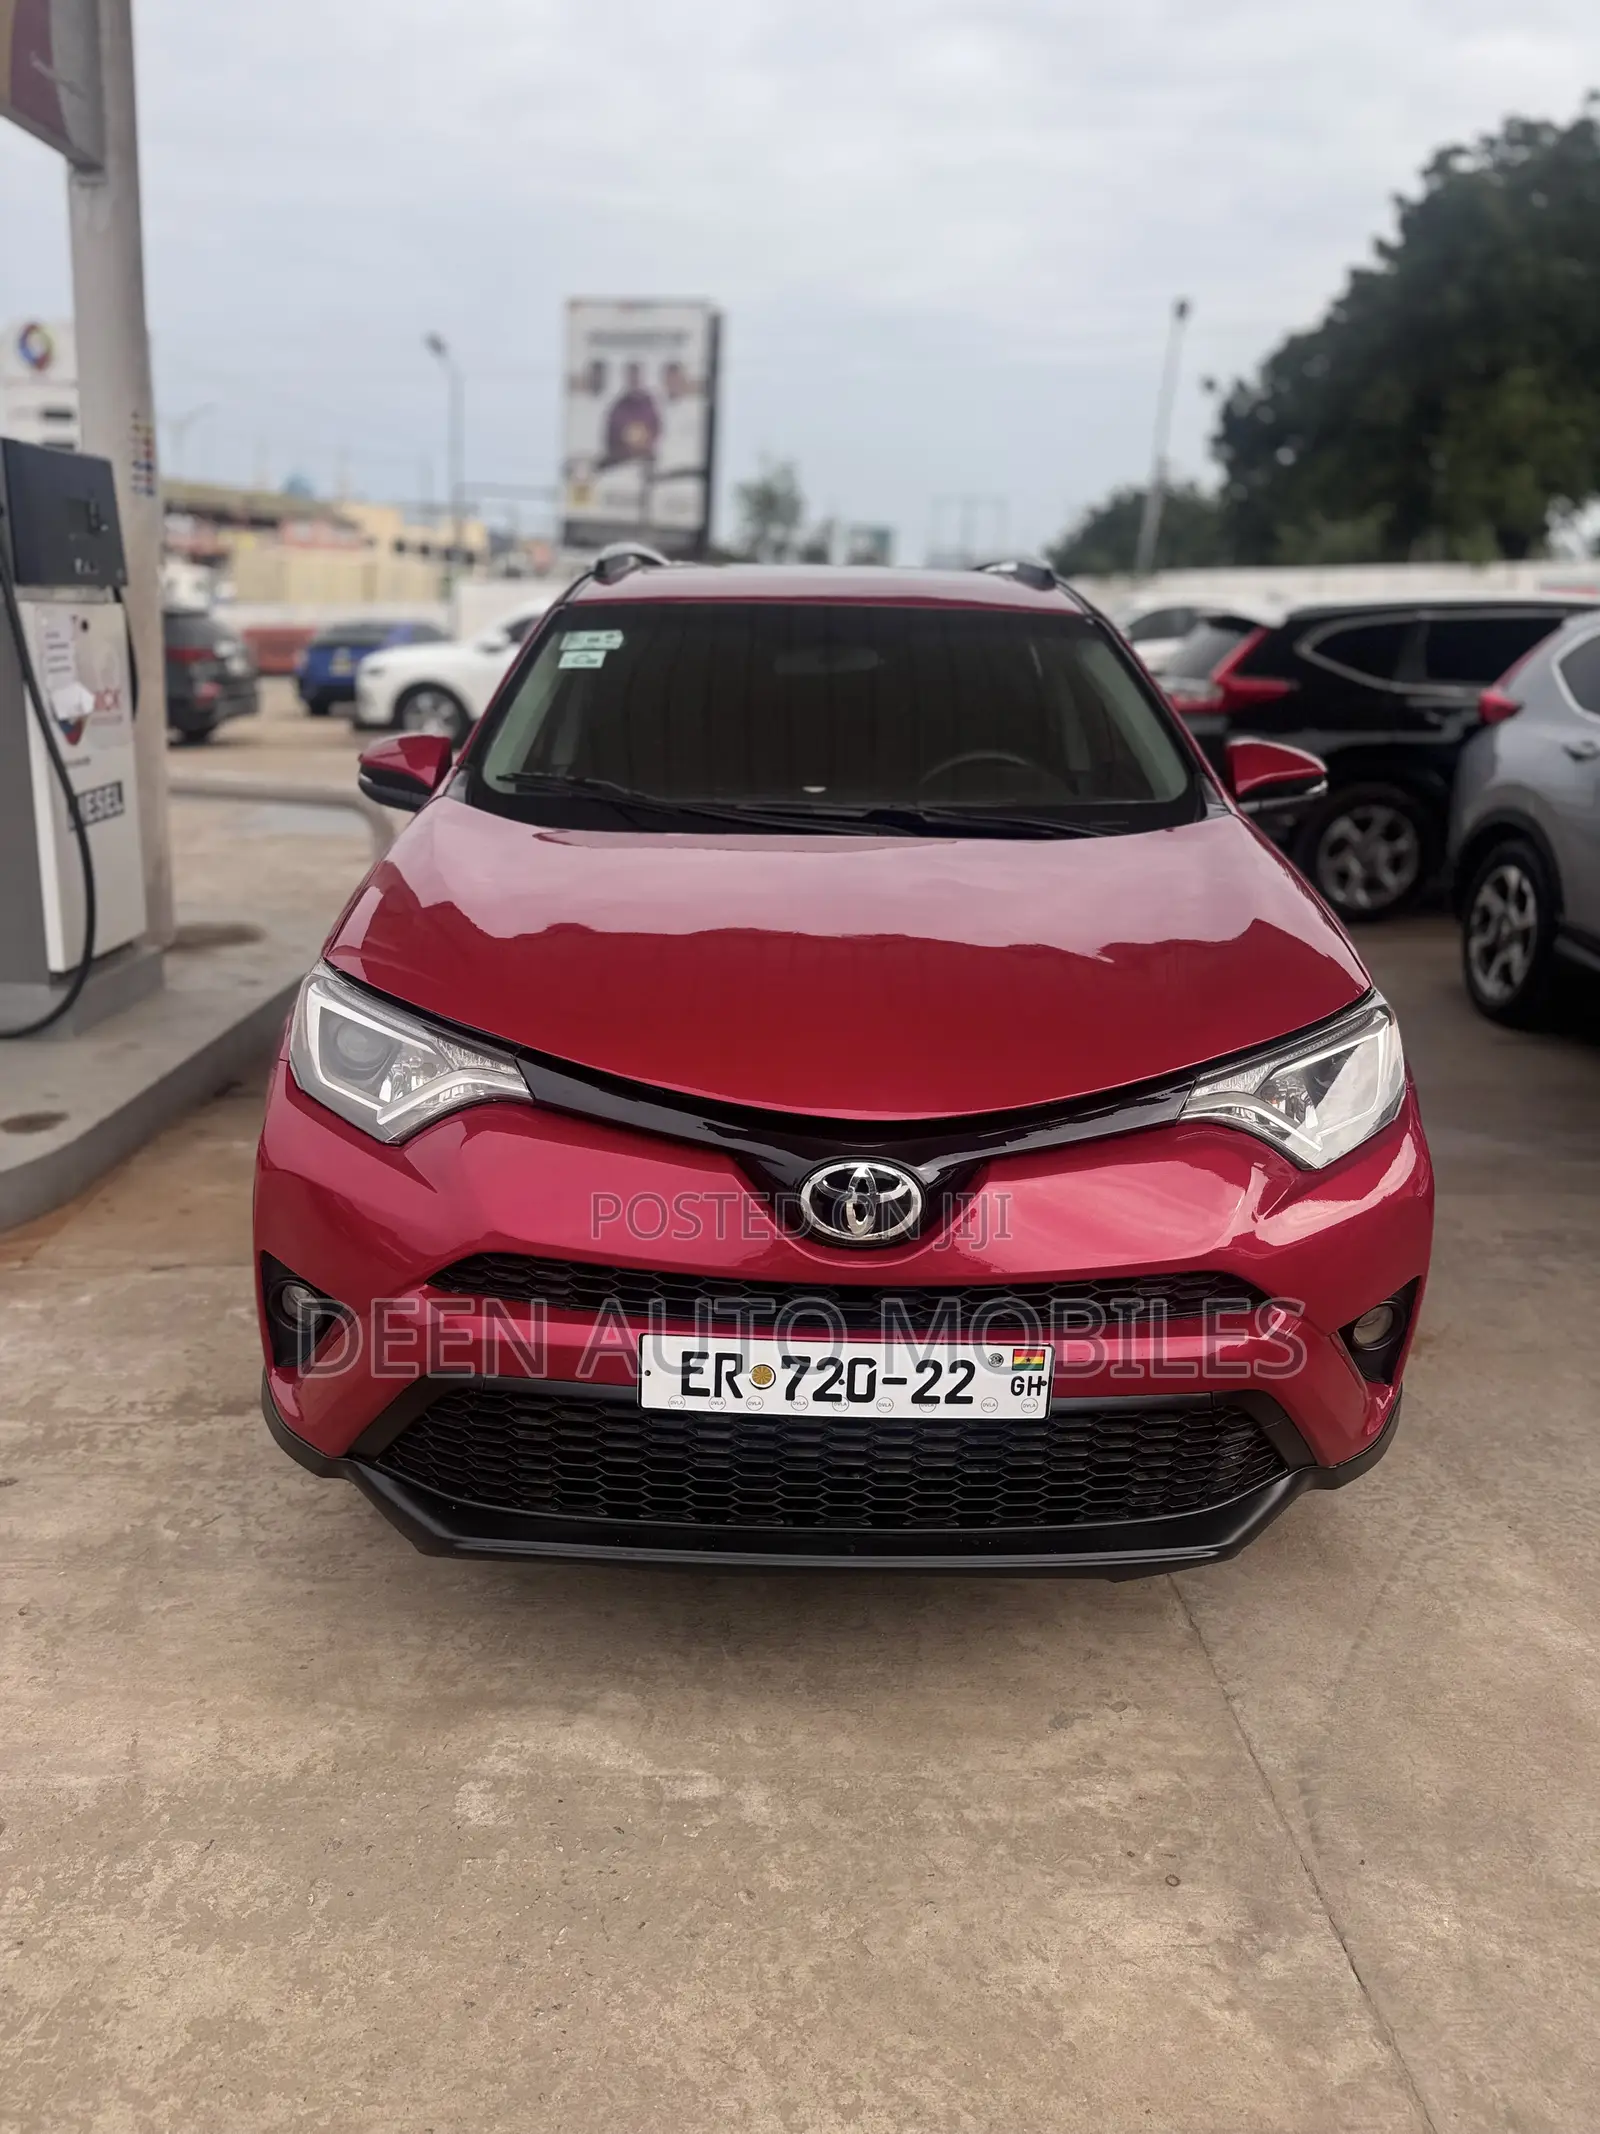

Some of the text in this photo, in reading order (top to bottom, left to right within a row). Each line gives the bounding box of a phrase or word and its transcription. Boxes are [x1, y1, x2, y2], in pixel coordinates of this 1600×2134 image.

[681, 1351, 976, 1405] ER 720-22
[1011, 1375, 1042, 1396] GH
